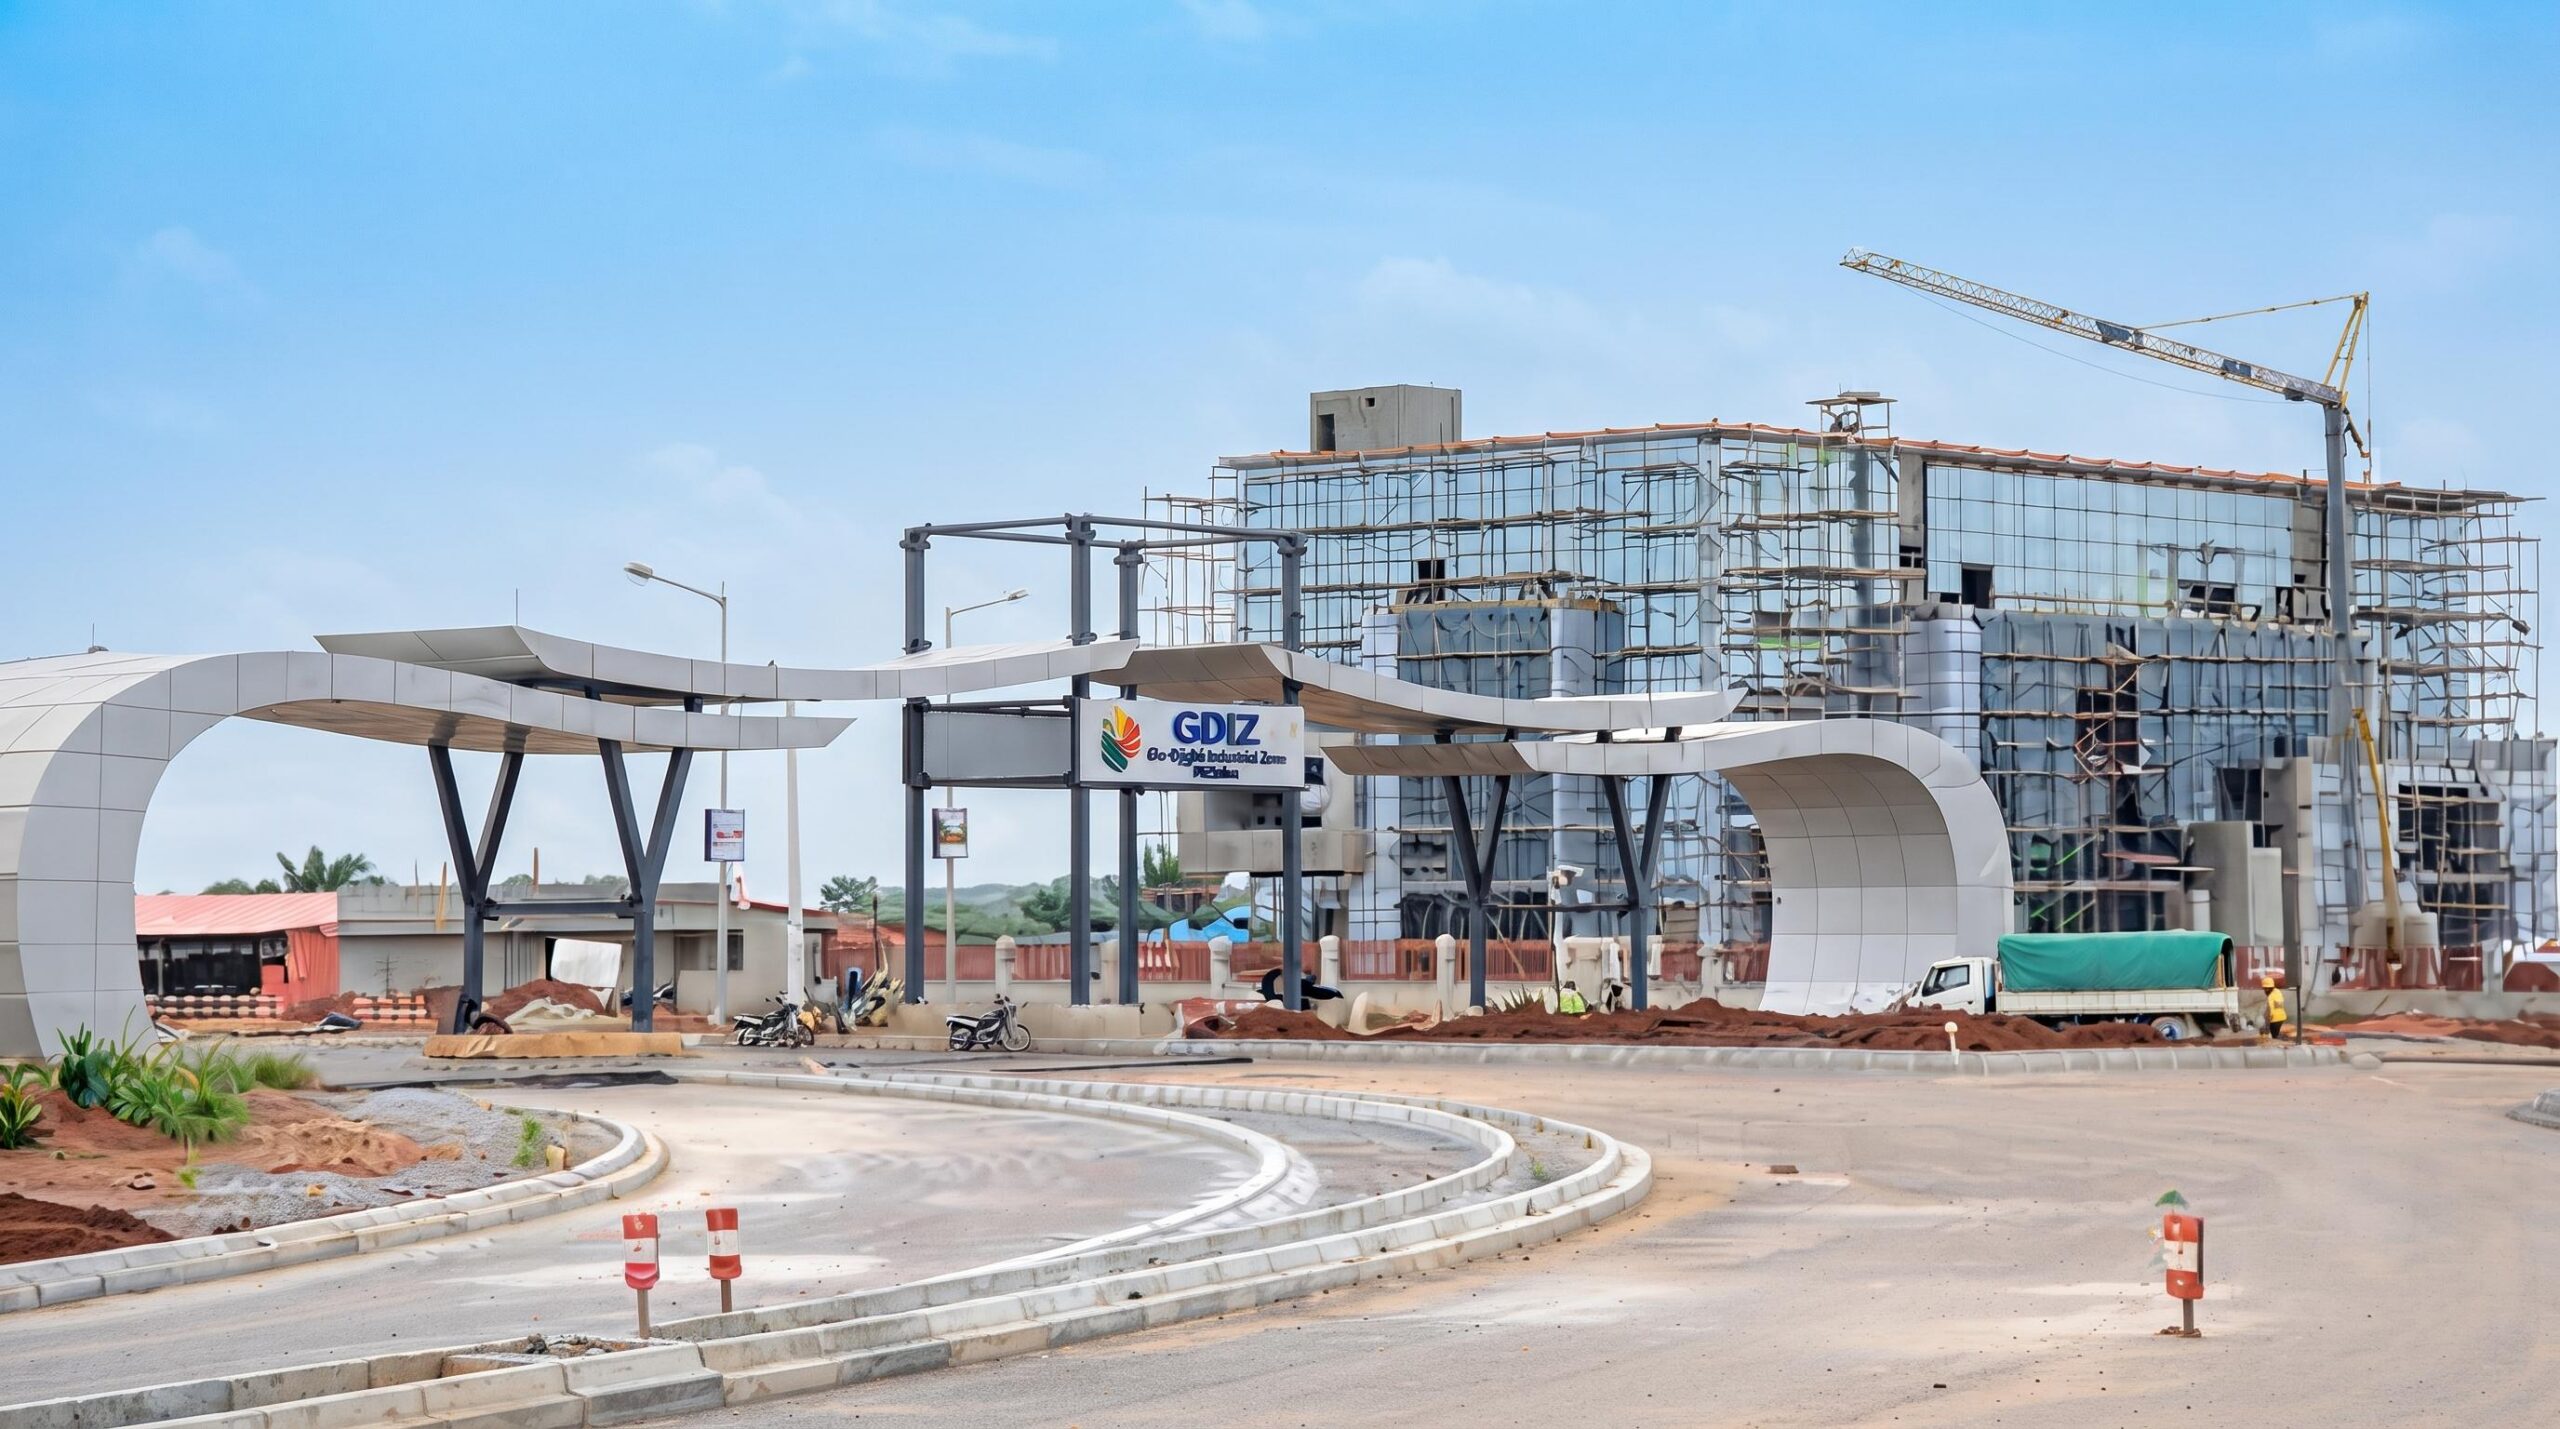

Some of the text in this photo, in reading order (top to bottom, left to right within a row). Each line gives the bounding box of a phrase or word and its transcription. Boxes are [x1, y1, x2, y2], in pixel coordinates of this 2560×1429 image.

[1174, 711, 1261, 745] GDIZ
[1207, 749, 1258, 764] Industrial
[1259, 750, 1287, 765] Zone
